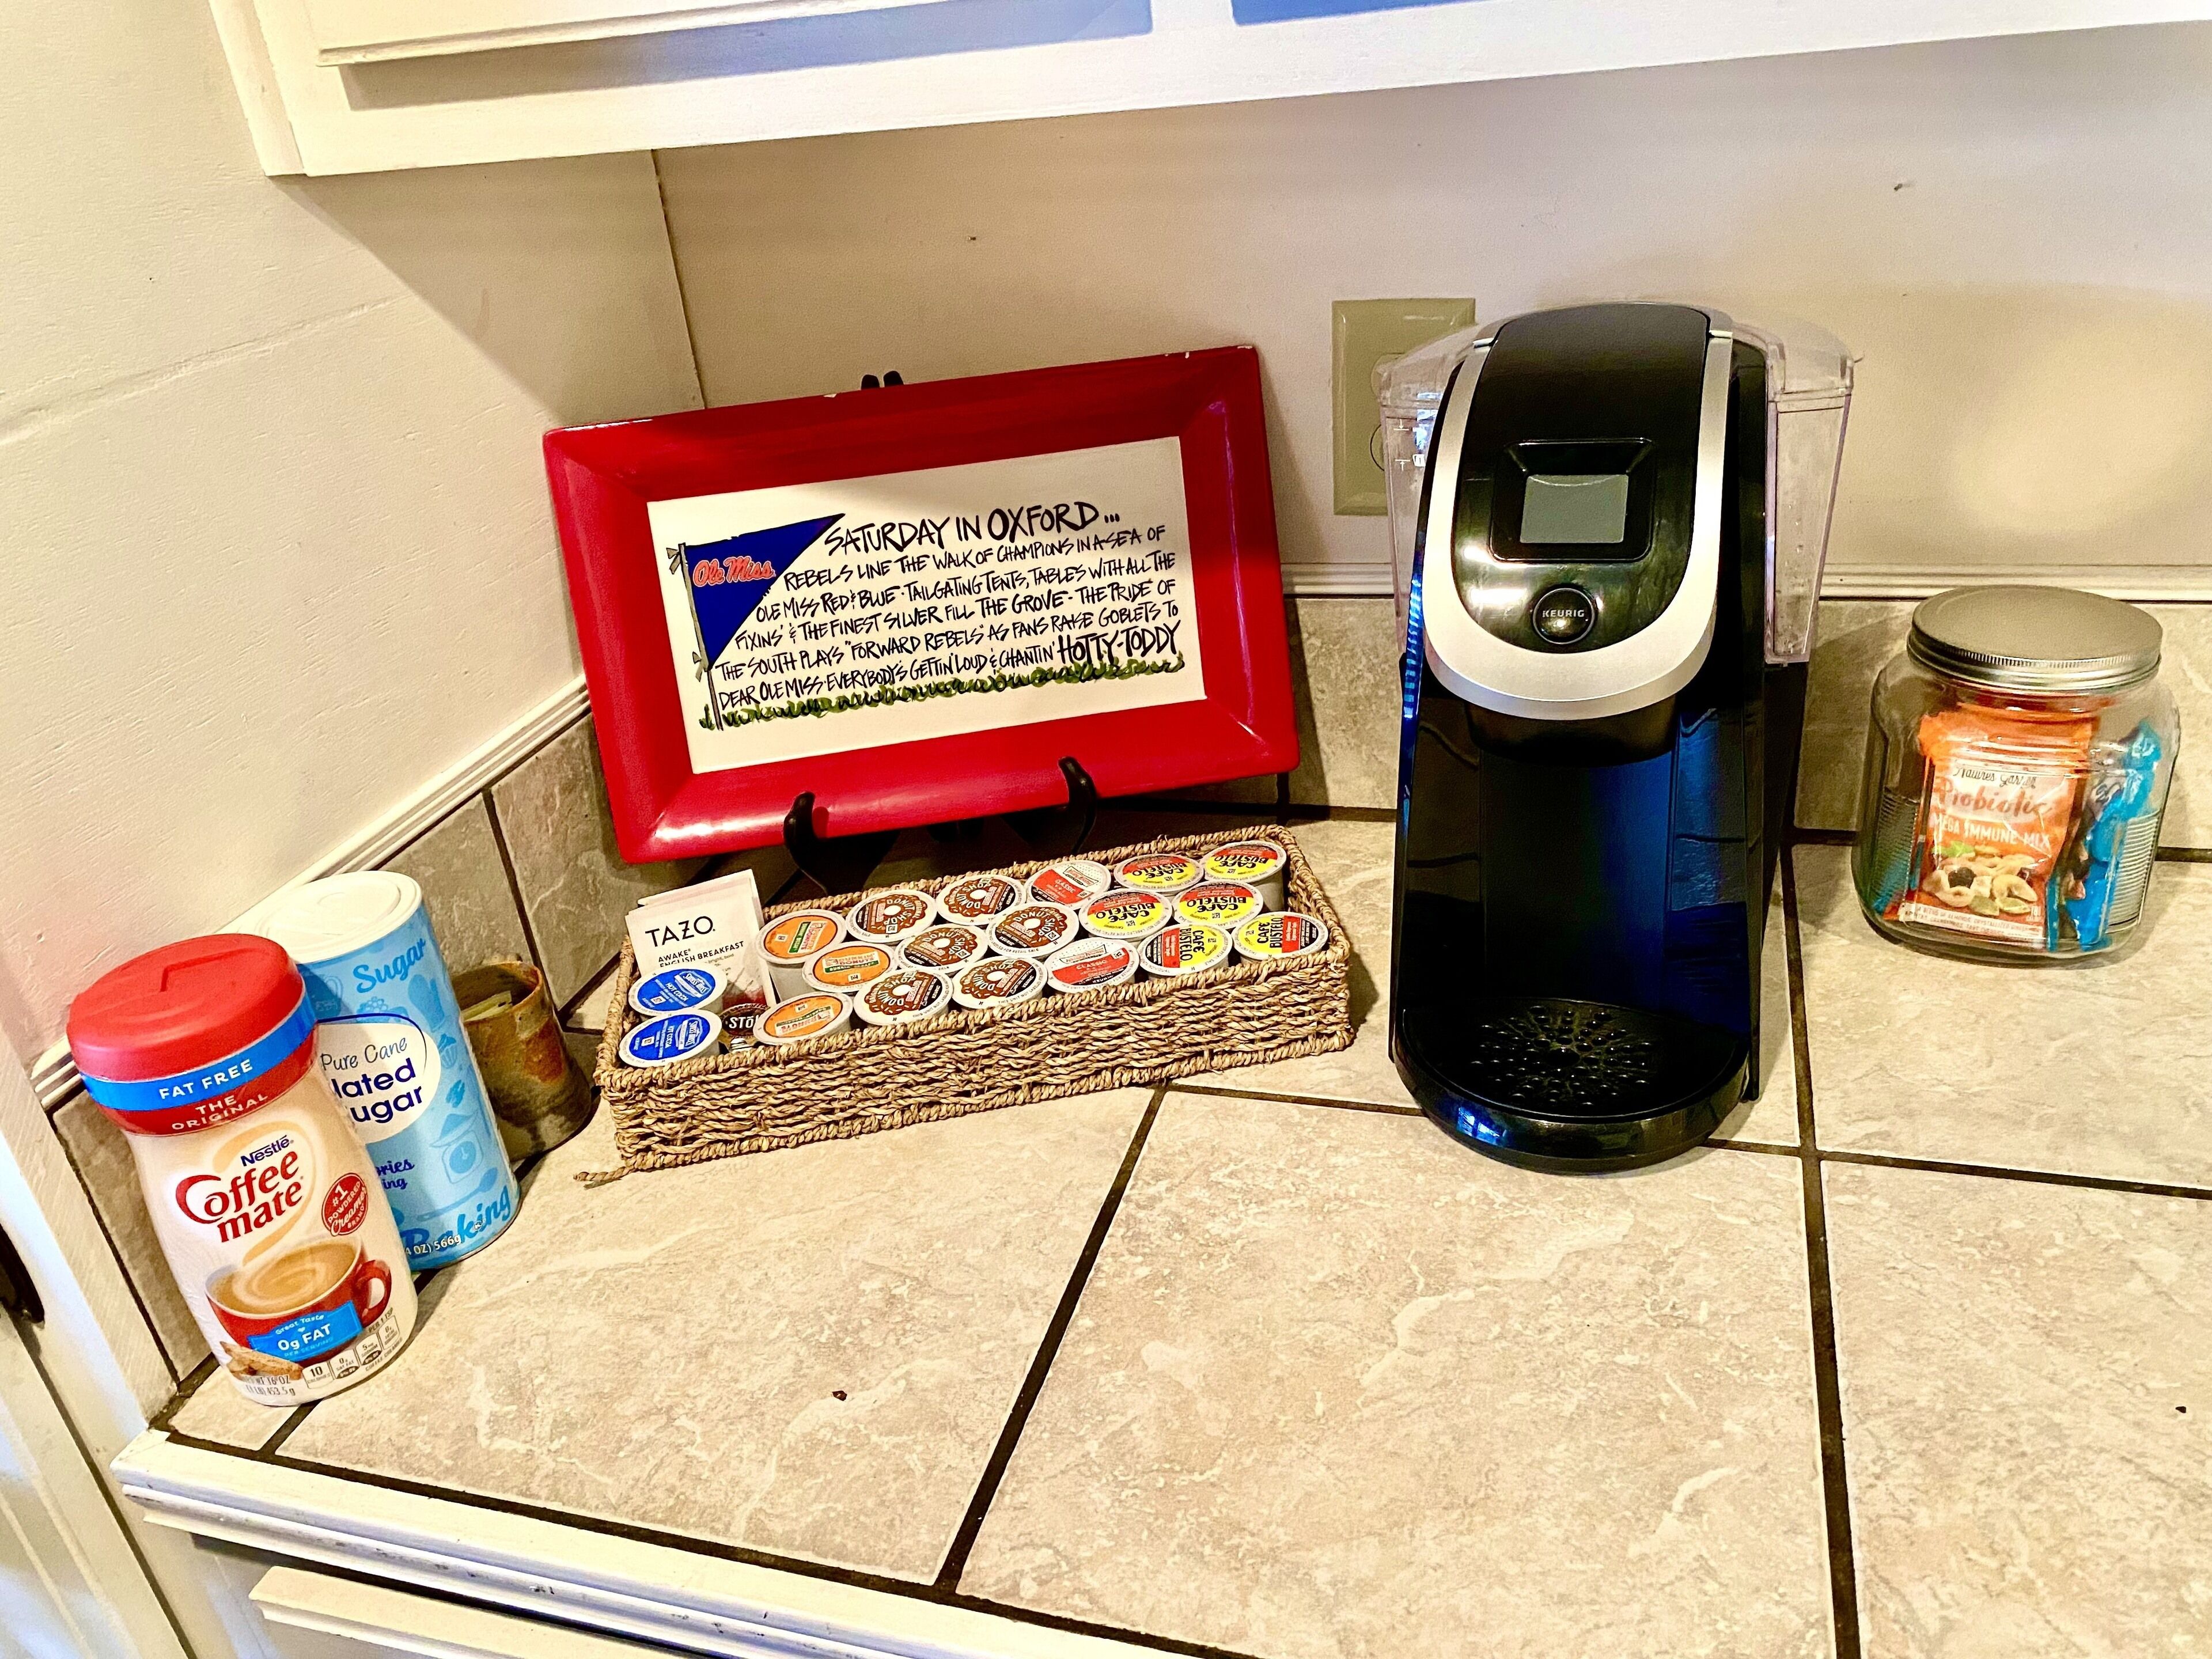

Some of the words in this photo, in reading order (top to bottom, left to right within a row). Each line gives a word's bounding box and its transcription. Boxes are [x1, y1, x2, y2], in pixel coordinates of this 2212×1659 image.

[824, 517, 950, 556] SATURDAY
[956, 515, 982, 541] IN
[692, 558, 725, 588] Ole
[723, 556, 776, 583] Miss
[783, 565, 853, 591] REBELS
[857, 560, 892, 579] LINE
[893, 555, 930, 574] THE
[933, 549, 976, 570] WALK
[975, 548, 993, 565] OF
[997, 538, 1074, 563] CHAMPIONS
[1077, 536, 1090, 553] IN
[1093, 534, 1105, 551] A
[1105, 528, 1142, 549] SEA
[1147, 525, 1165, 541] OF
[756, 603, 781, 623] OLE
[783, 597, 820, 619] MISS
[820, 592, 849, 615] RED
[857, 585, 900, 609] BLUE
[904, 575, 982, 601] TAILGATING
[979, 570, 1029, 593] TENTS,
[1028, 564, 1086, 585] TABLES
[1088, 558, 1124, 579] WITH
[1126, 557, 1152, 575] ALL
[1145, 550, 1176, 571] THE
[734, 624, 783, 651] FIXINS'
[797, 621, 829, 641] THE
[830, 612, 882, 637] FINEST
[884, 606, 944, 630] SILVER
[945, 605, 975, 621] FILL
[975, 597, 1008, 618] THE
[1075, 586, 1108, 604] THE
[1107, 581, 1153, 603] PRIDE
[1157, 579, 1176, 594] OF
[1542, 609, 1585, 618] KEURIG
[715, 661, 746, 681] THE
[748, 652, 797, 678] SOUTH
[799, 646, 844, 669] PLAYS
[987, 623, 1009, 641] AS
[1012, 616, 1049, 639] FANS
[1050, 612, 1094, 632] RAISE
[1099, 601, 1161, 627] GOBLETS
[719, 685, 760, 710] DEAR
[760, 681, 783, 701] OLE
[785, 676, 823, 698] MISS
[827, 660, 908, 691] EVERYBODY'S
[955, 653, 987, 674] LOUD
[999, 641, 1055, 668] CHANTIN'
[1057, 620, 1181, 665] HOTTY-TODDY
[1964, 819, 2017, 844] IMMUNE
[2023, 832, 2050, 847] MIX
[1214, 855, 1269, 864] BUSTELO
[956, 893, 981, 909] DONUT
[963, 882, 991, 893] SHOP
[1187, 896, 1247, 907] BUSTELO
[883, 910, 912, 925] SHOP
[886, 897, 915, 911] DONUT
[1094, 903, 1156, 919] BUSTELO
[645, 916, 713, 947] TAZO
[1013, 911, 1047, 923] DONUT
[1037, 917, 1055, 937] SHOP
[1270, 917, 1284, 948] BUSTELO
[658, 950, 688, 963] AWAKE
[698, 941, 744, 959] BREAKFAST
[922, 931, 959, 943] DONUT
[948, 937, 965, 955] SHOP
[1180, 928, 1193, 961] BUSTELO
[353, 938, 426, 993] Sugar
[982, 963, 1014, 974] SHOP
[884, 977, 916, 989] SHOP
[972, 974, 995, 991] DONUT
[877, 990, 905, 1007] DONUT
[320, 1053, 358, 1071] Pure
[365, 1037, 407, 1063] Cane
[159, 1082, 194, 1100] FAT
[201, 1059, 253, 1090] FREE
[331, 1058, 415, 1099] lated
[171, 1094, 268, 1131] ORIGINAL
[195, 1094, 238, 1115] THE
[350, 1086, 422, 1124] ugar
[175, 1152, 300, 1224] Coffee
[328, 1181, 361, 1223] POWDERED
[217, 1181, 303, 1243] mate
[347, 1205, 365, 1229] BRAND
[400, 1185, 510, 1259] Baking
[414, 1244, 432, 1255] OZ)
[434, 1234, 462, 1251] 566g
[275, 1319, 300, 1335] Great
[300, 1313, 325, 1324] Taste
[277, 1339, 300, 1351] 0g
[301, 1323, 332, 1345] FAT
[309, 1366, 323, 1377] 10
